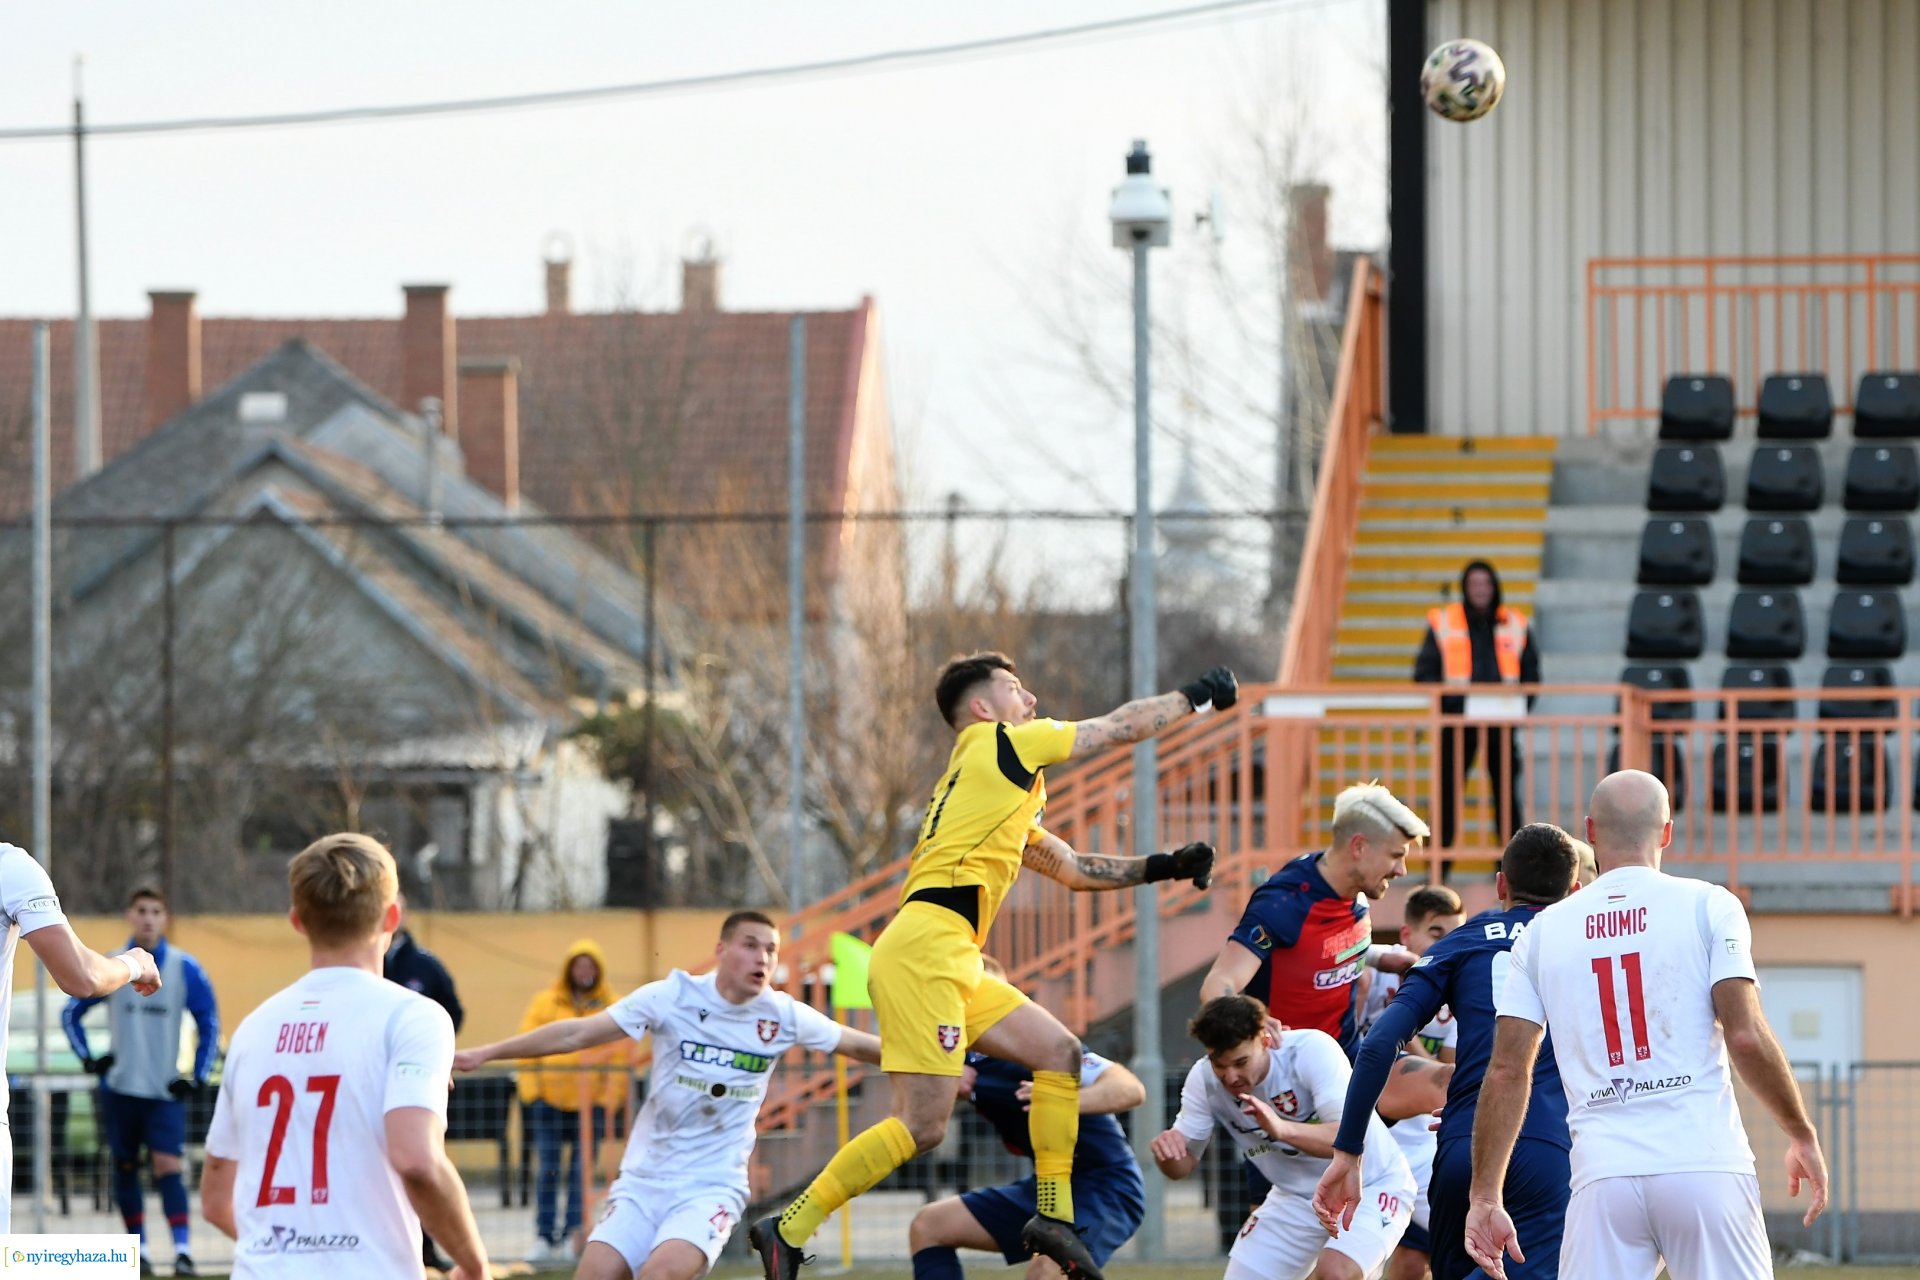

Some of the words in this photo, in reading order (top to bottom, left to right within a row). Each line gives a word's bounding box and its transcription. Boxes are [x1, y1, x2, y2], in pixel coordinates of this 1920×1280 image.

[1585, 907, 1648, 940] GRUMIC
[1591, 951, 1652, 1068] 11
[275, 1021, 330, 1054] BIBEN
[1590, 1086, 1616, 1100] VIVA
[1634, 1075, 1692, 1093] PALAZZO
[255, 1074, 342, 1208] 27
